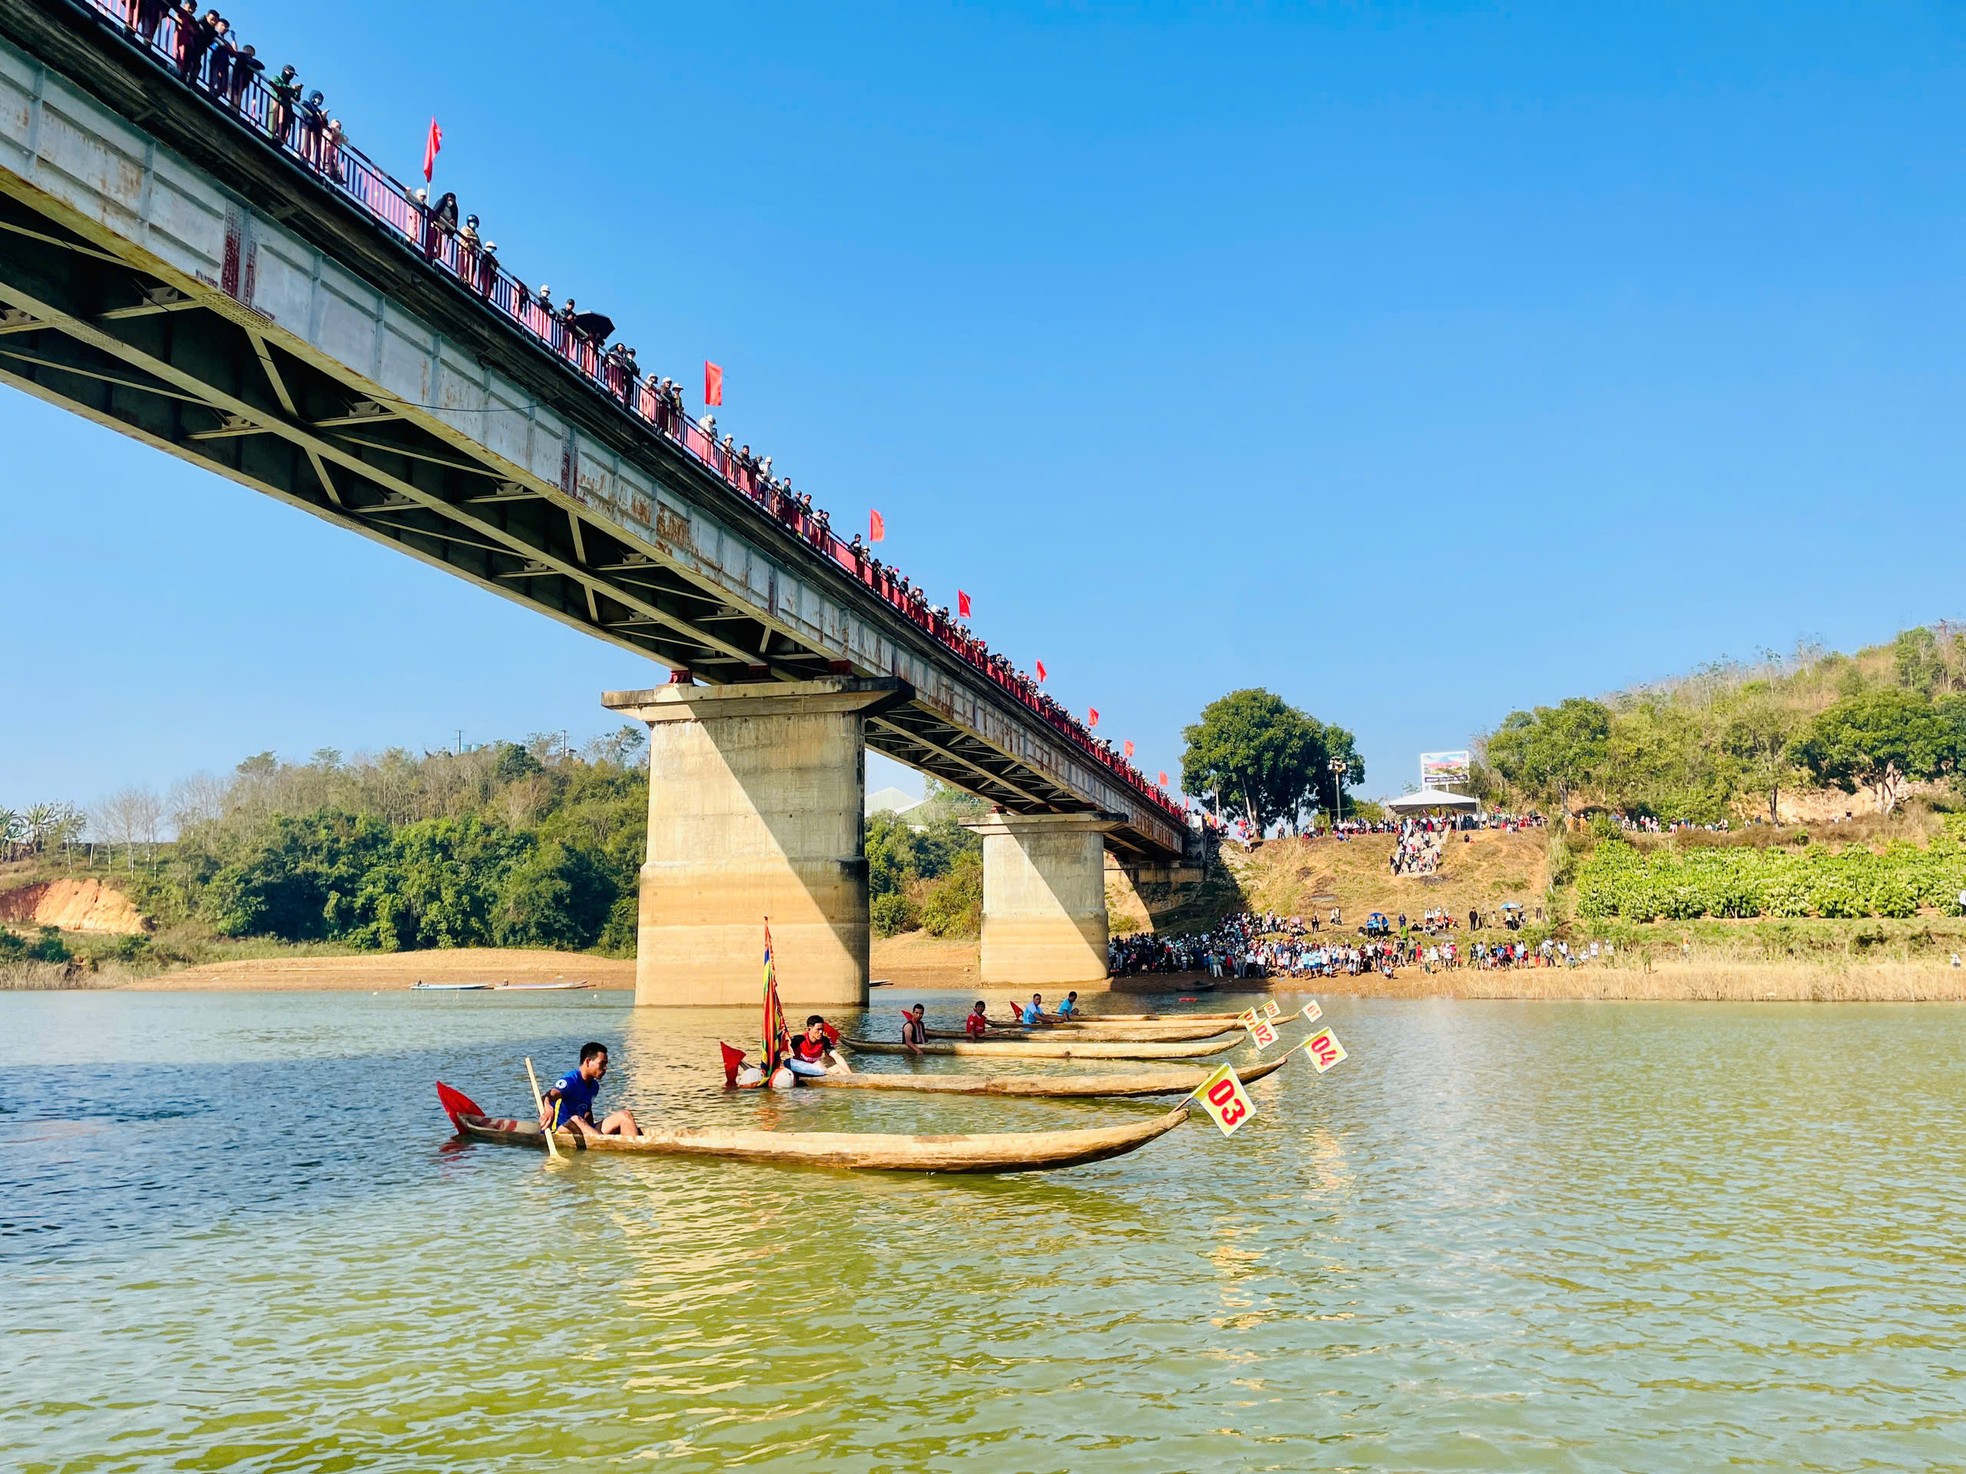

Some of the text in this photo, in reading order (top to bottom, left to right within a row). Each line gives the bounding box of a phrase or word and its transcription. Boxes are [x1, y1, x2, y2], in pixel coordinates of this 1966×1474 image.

[1307, 1005, 1320, 1018] 01
[1255, 1025, 1273, 1046] 02
[1311, 1036, 1337, 1066] 04
[1207, 1078, 1246, 1126] 03
